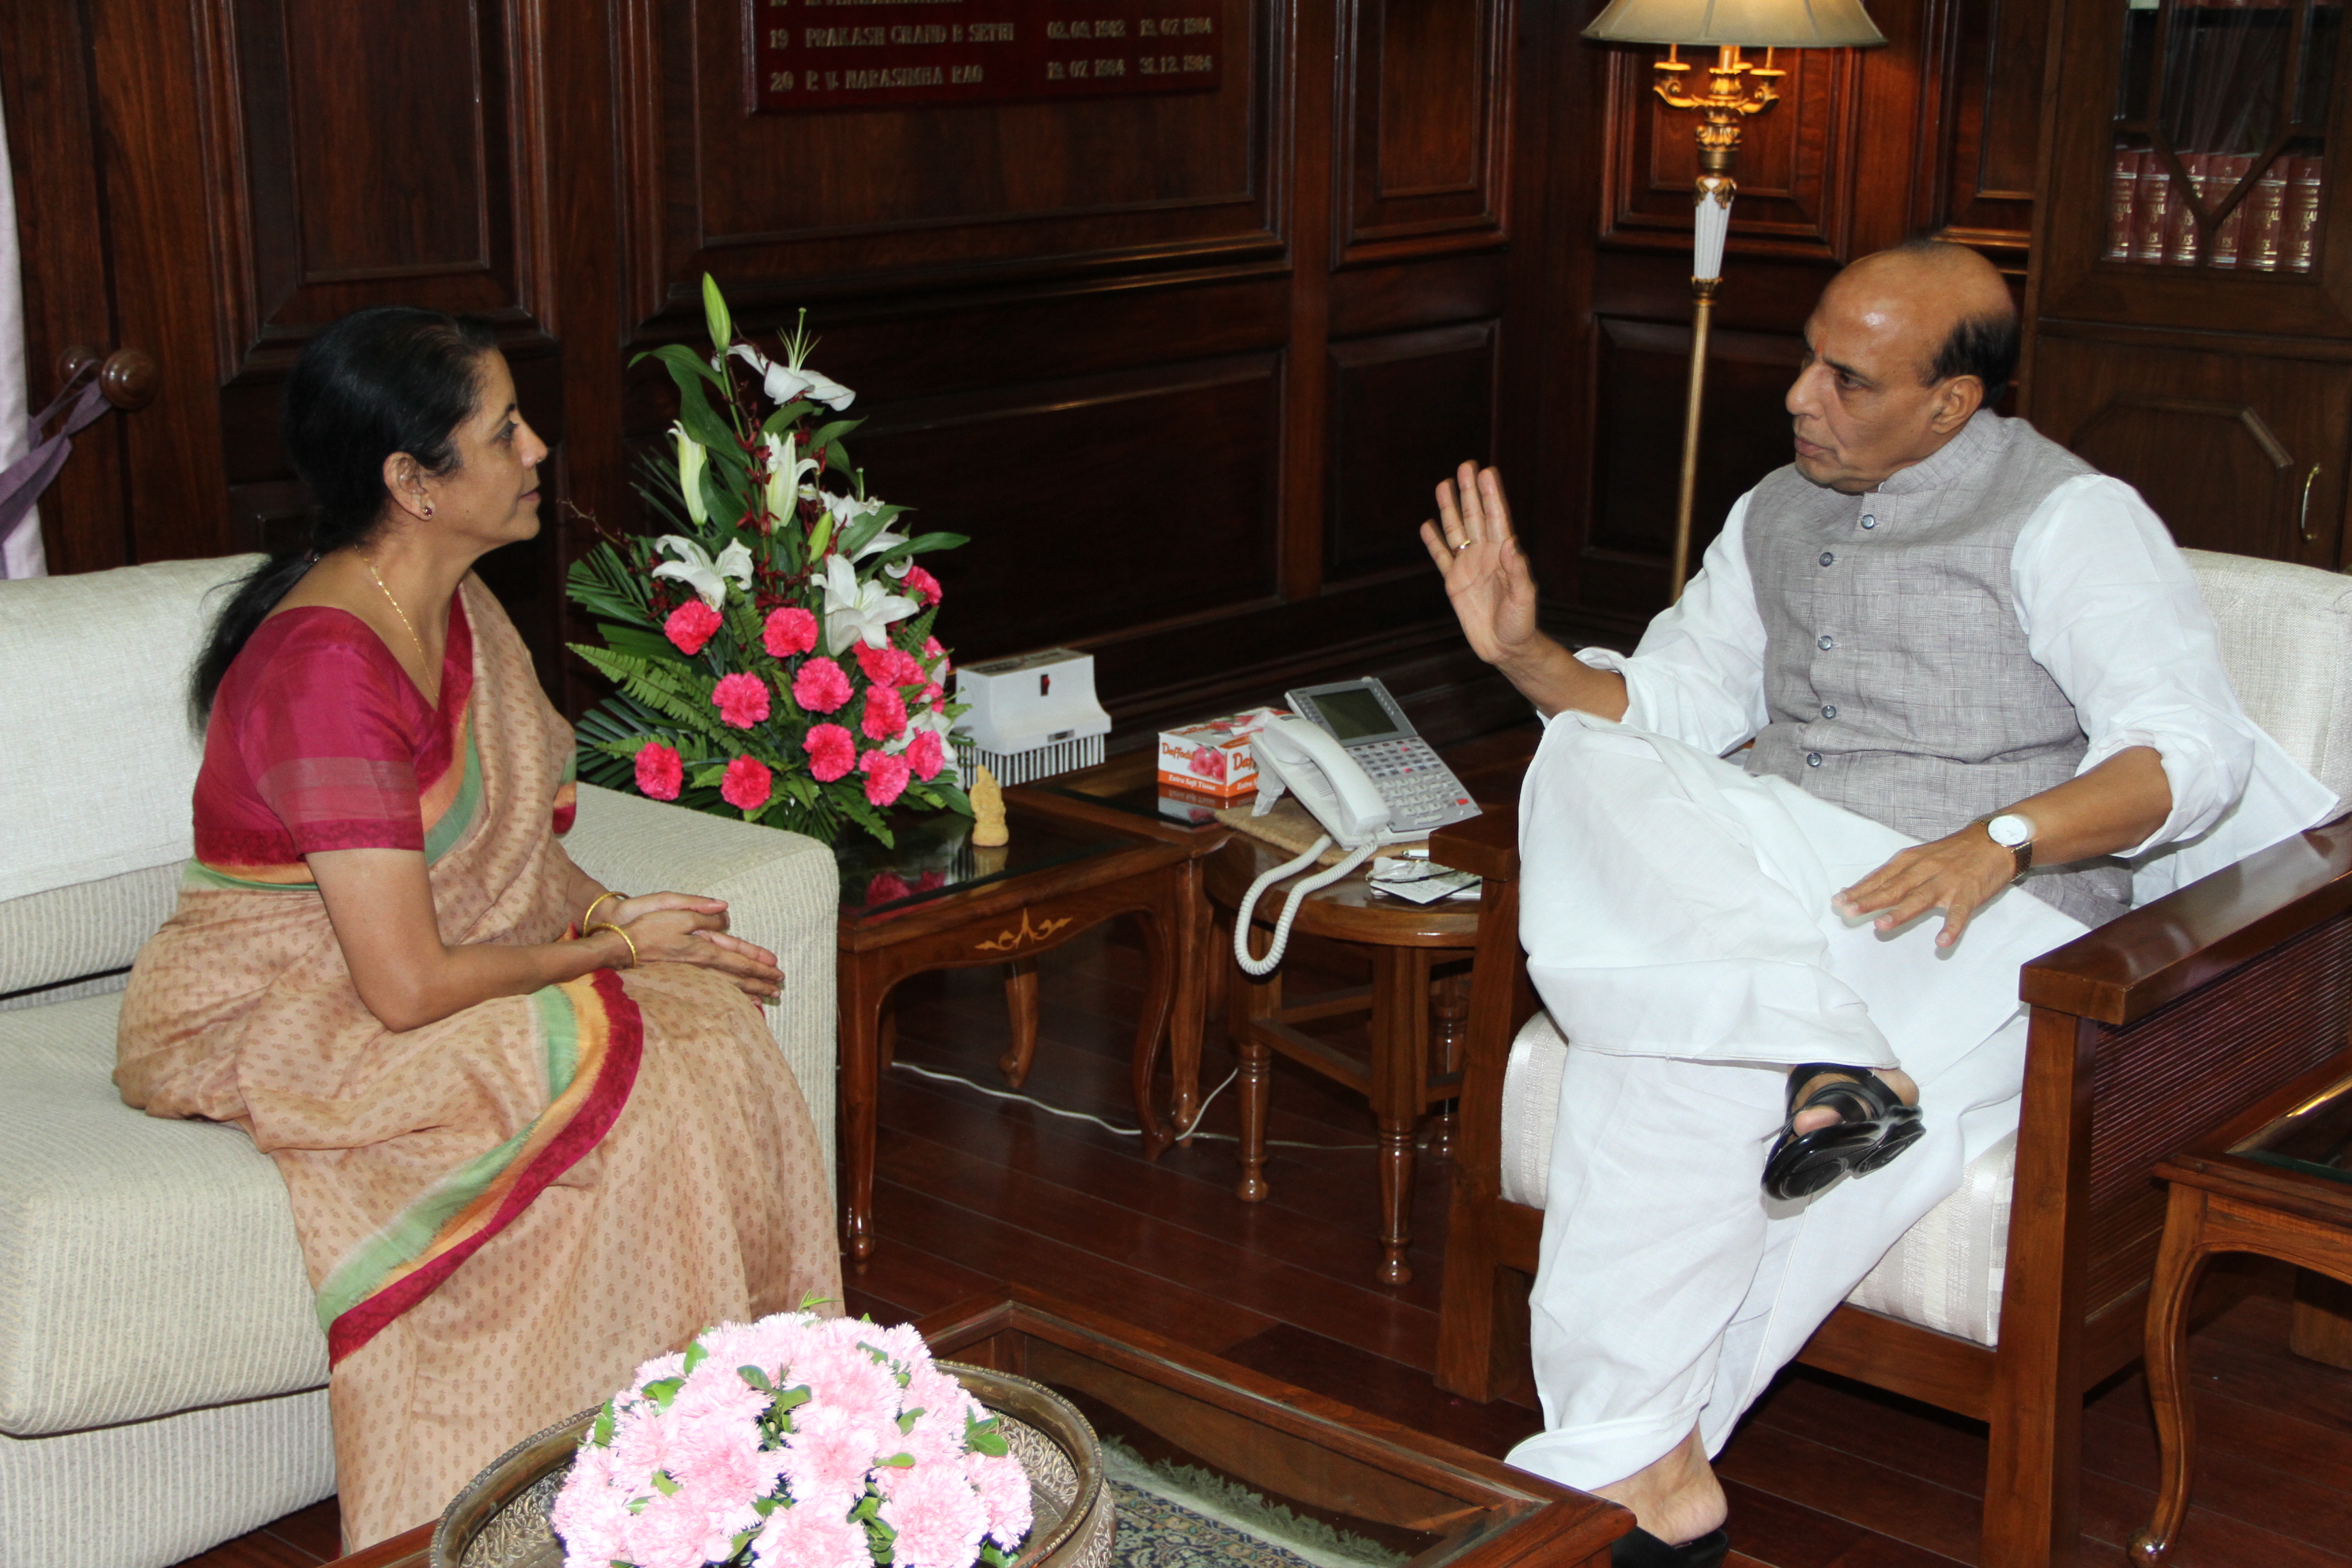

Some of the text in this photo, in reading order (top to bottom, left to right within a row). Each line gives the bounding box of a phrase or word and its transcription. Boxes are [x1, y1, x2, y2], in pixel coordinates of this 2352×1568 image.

[770, 29, 789, 49] 19
[806, 27, 885, 48] PRAKASH
[890, 25, 947, 44] CHAND
[968, 22, 1014, 42] SETHI
[770, 71, 794, 92] 20
[845, 67, 945, 89] NARASIMHA
[952, 65, 984, 83] RAO
[2116, 161, 2123, 172] 2
[2189, 164, 2196, 174] 4
[2304, 167, 2312, 177] 7
